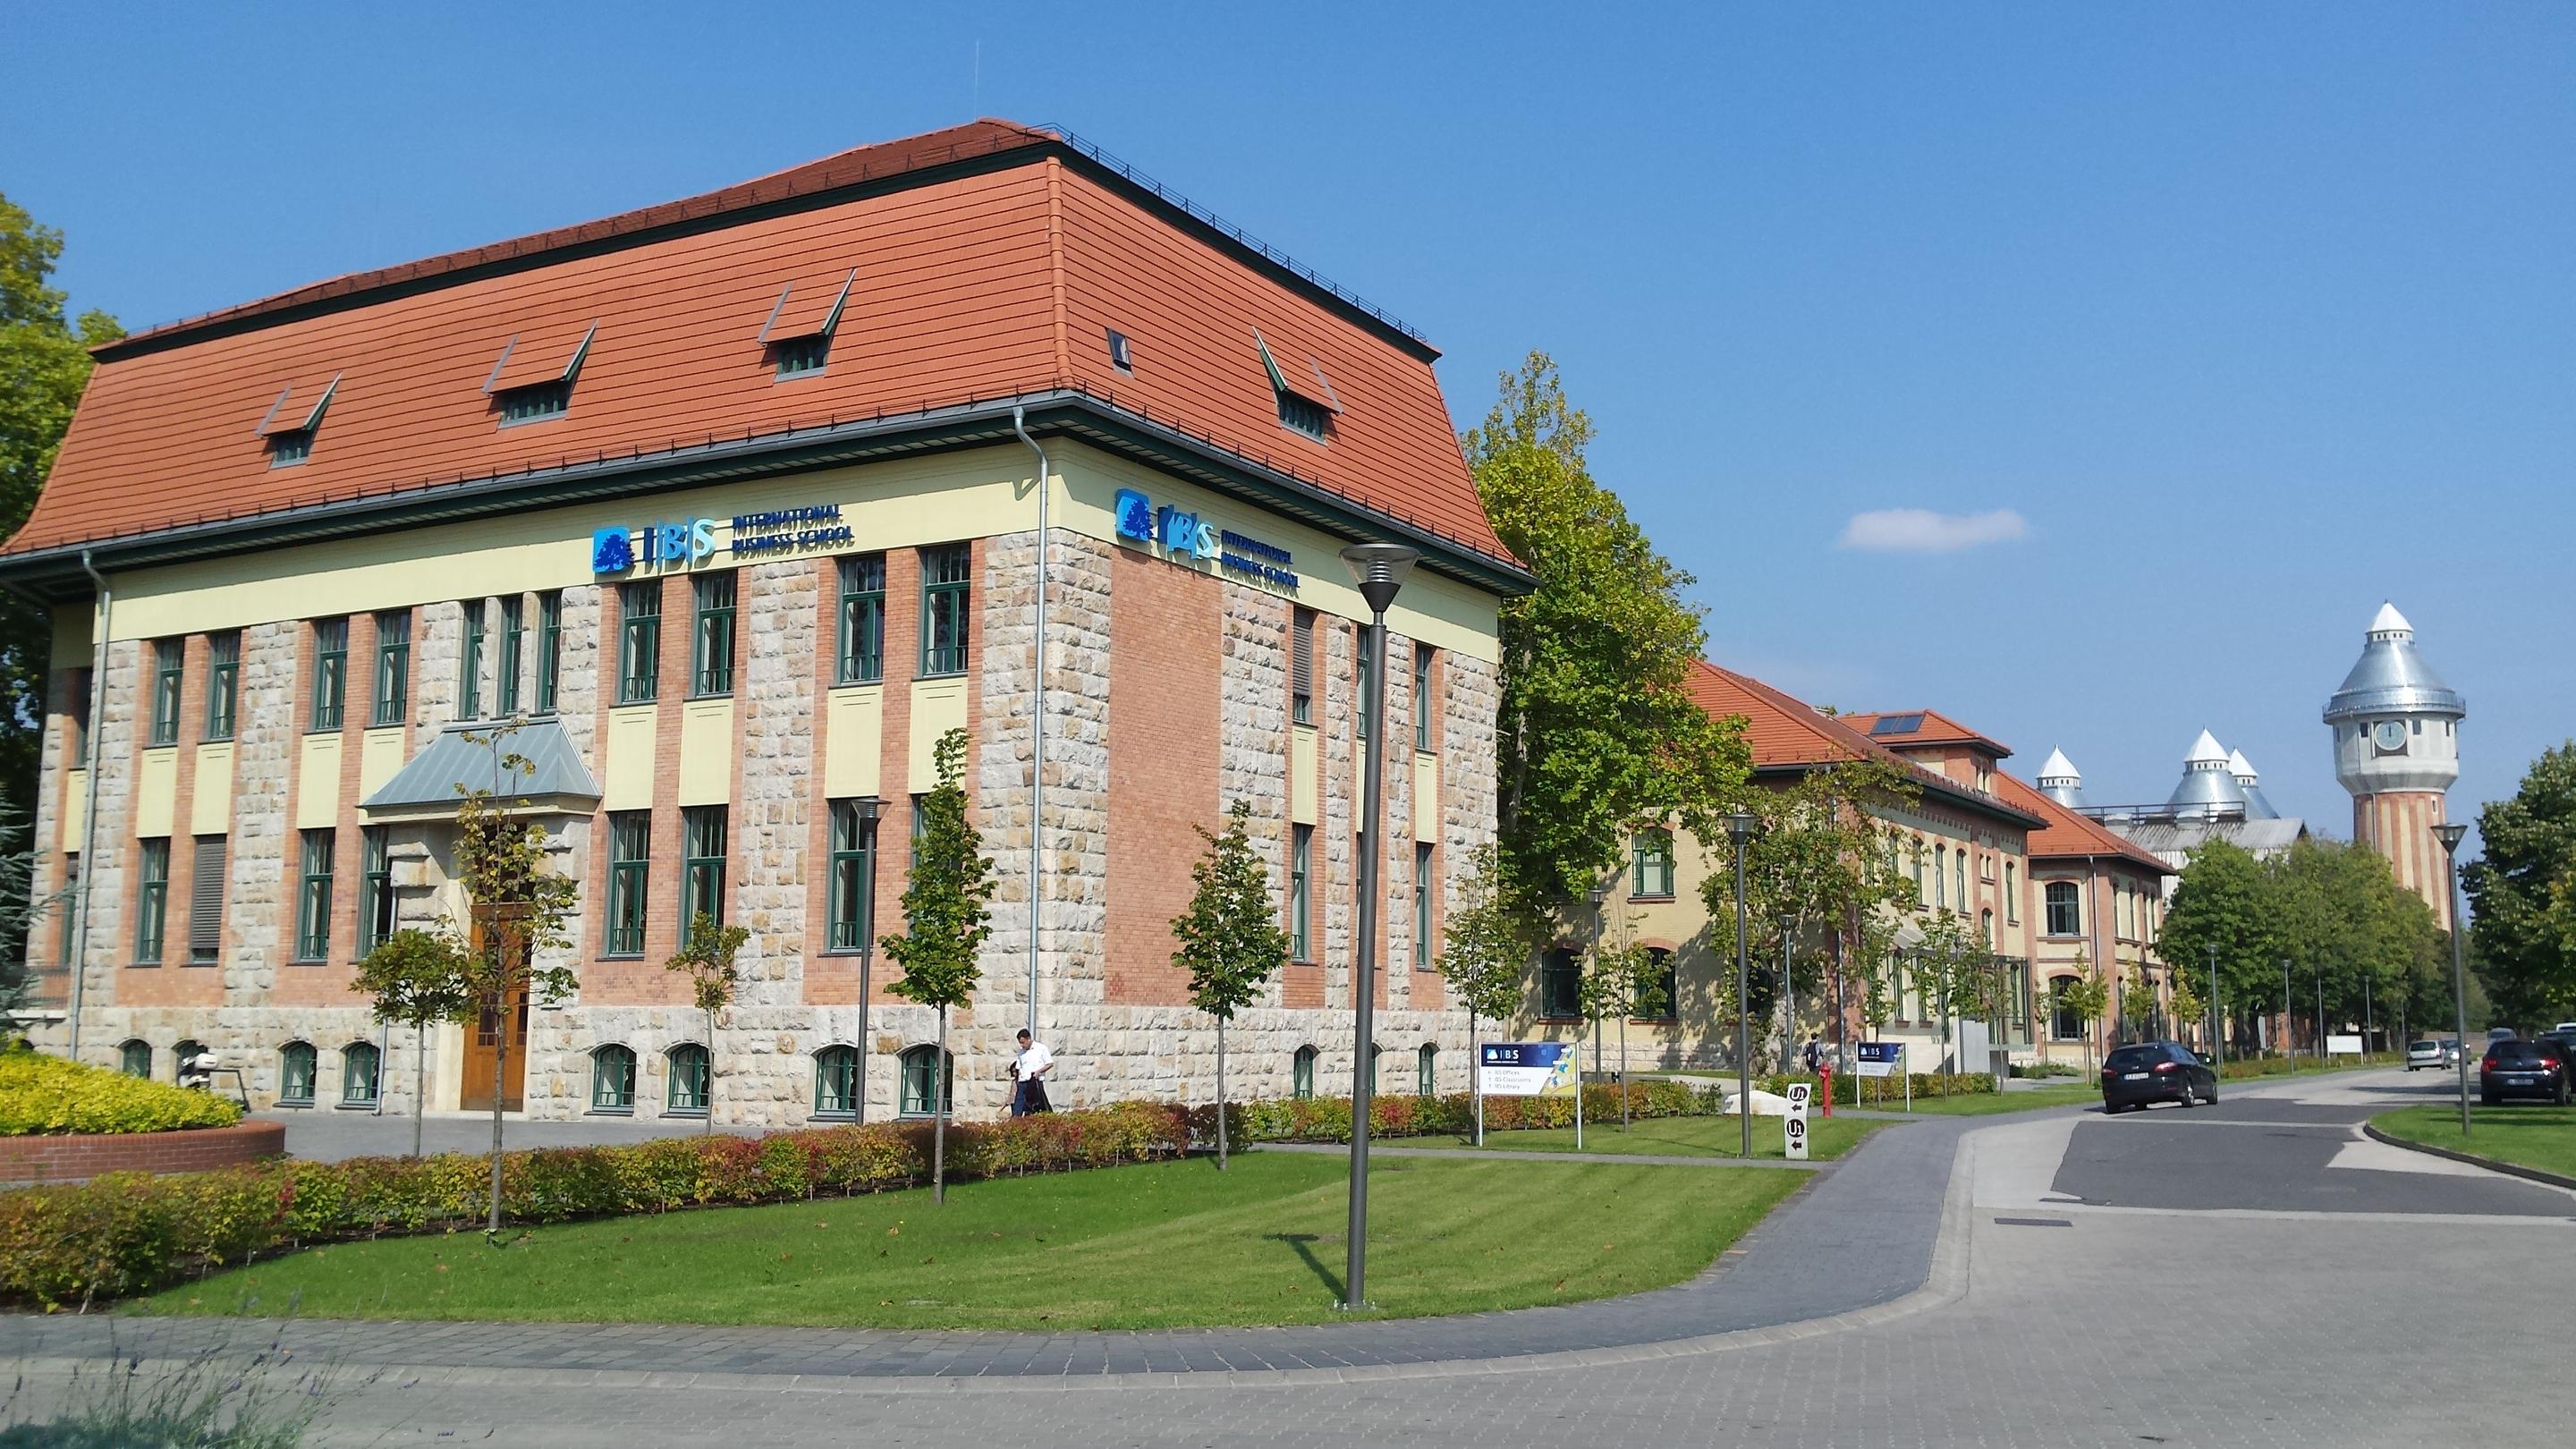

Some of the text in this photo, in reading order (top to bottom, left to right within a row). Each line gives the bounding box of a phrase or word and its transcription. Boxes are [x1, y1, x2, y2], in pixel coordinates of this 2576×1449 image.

[732, 504, 843, 530] INTERNATIONAL
[731, 525, 854, 552] BUSINESS SCHOOL
